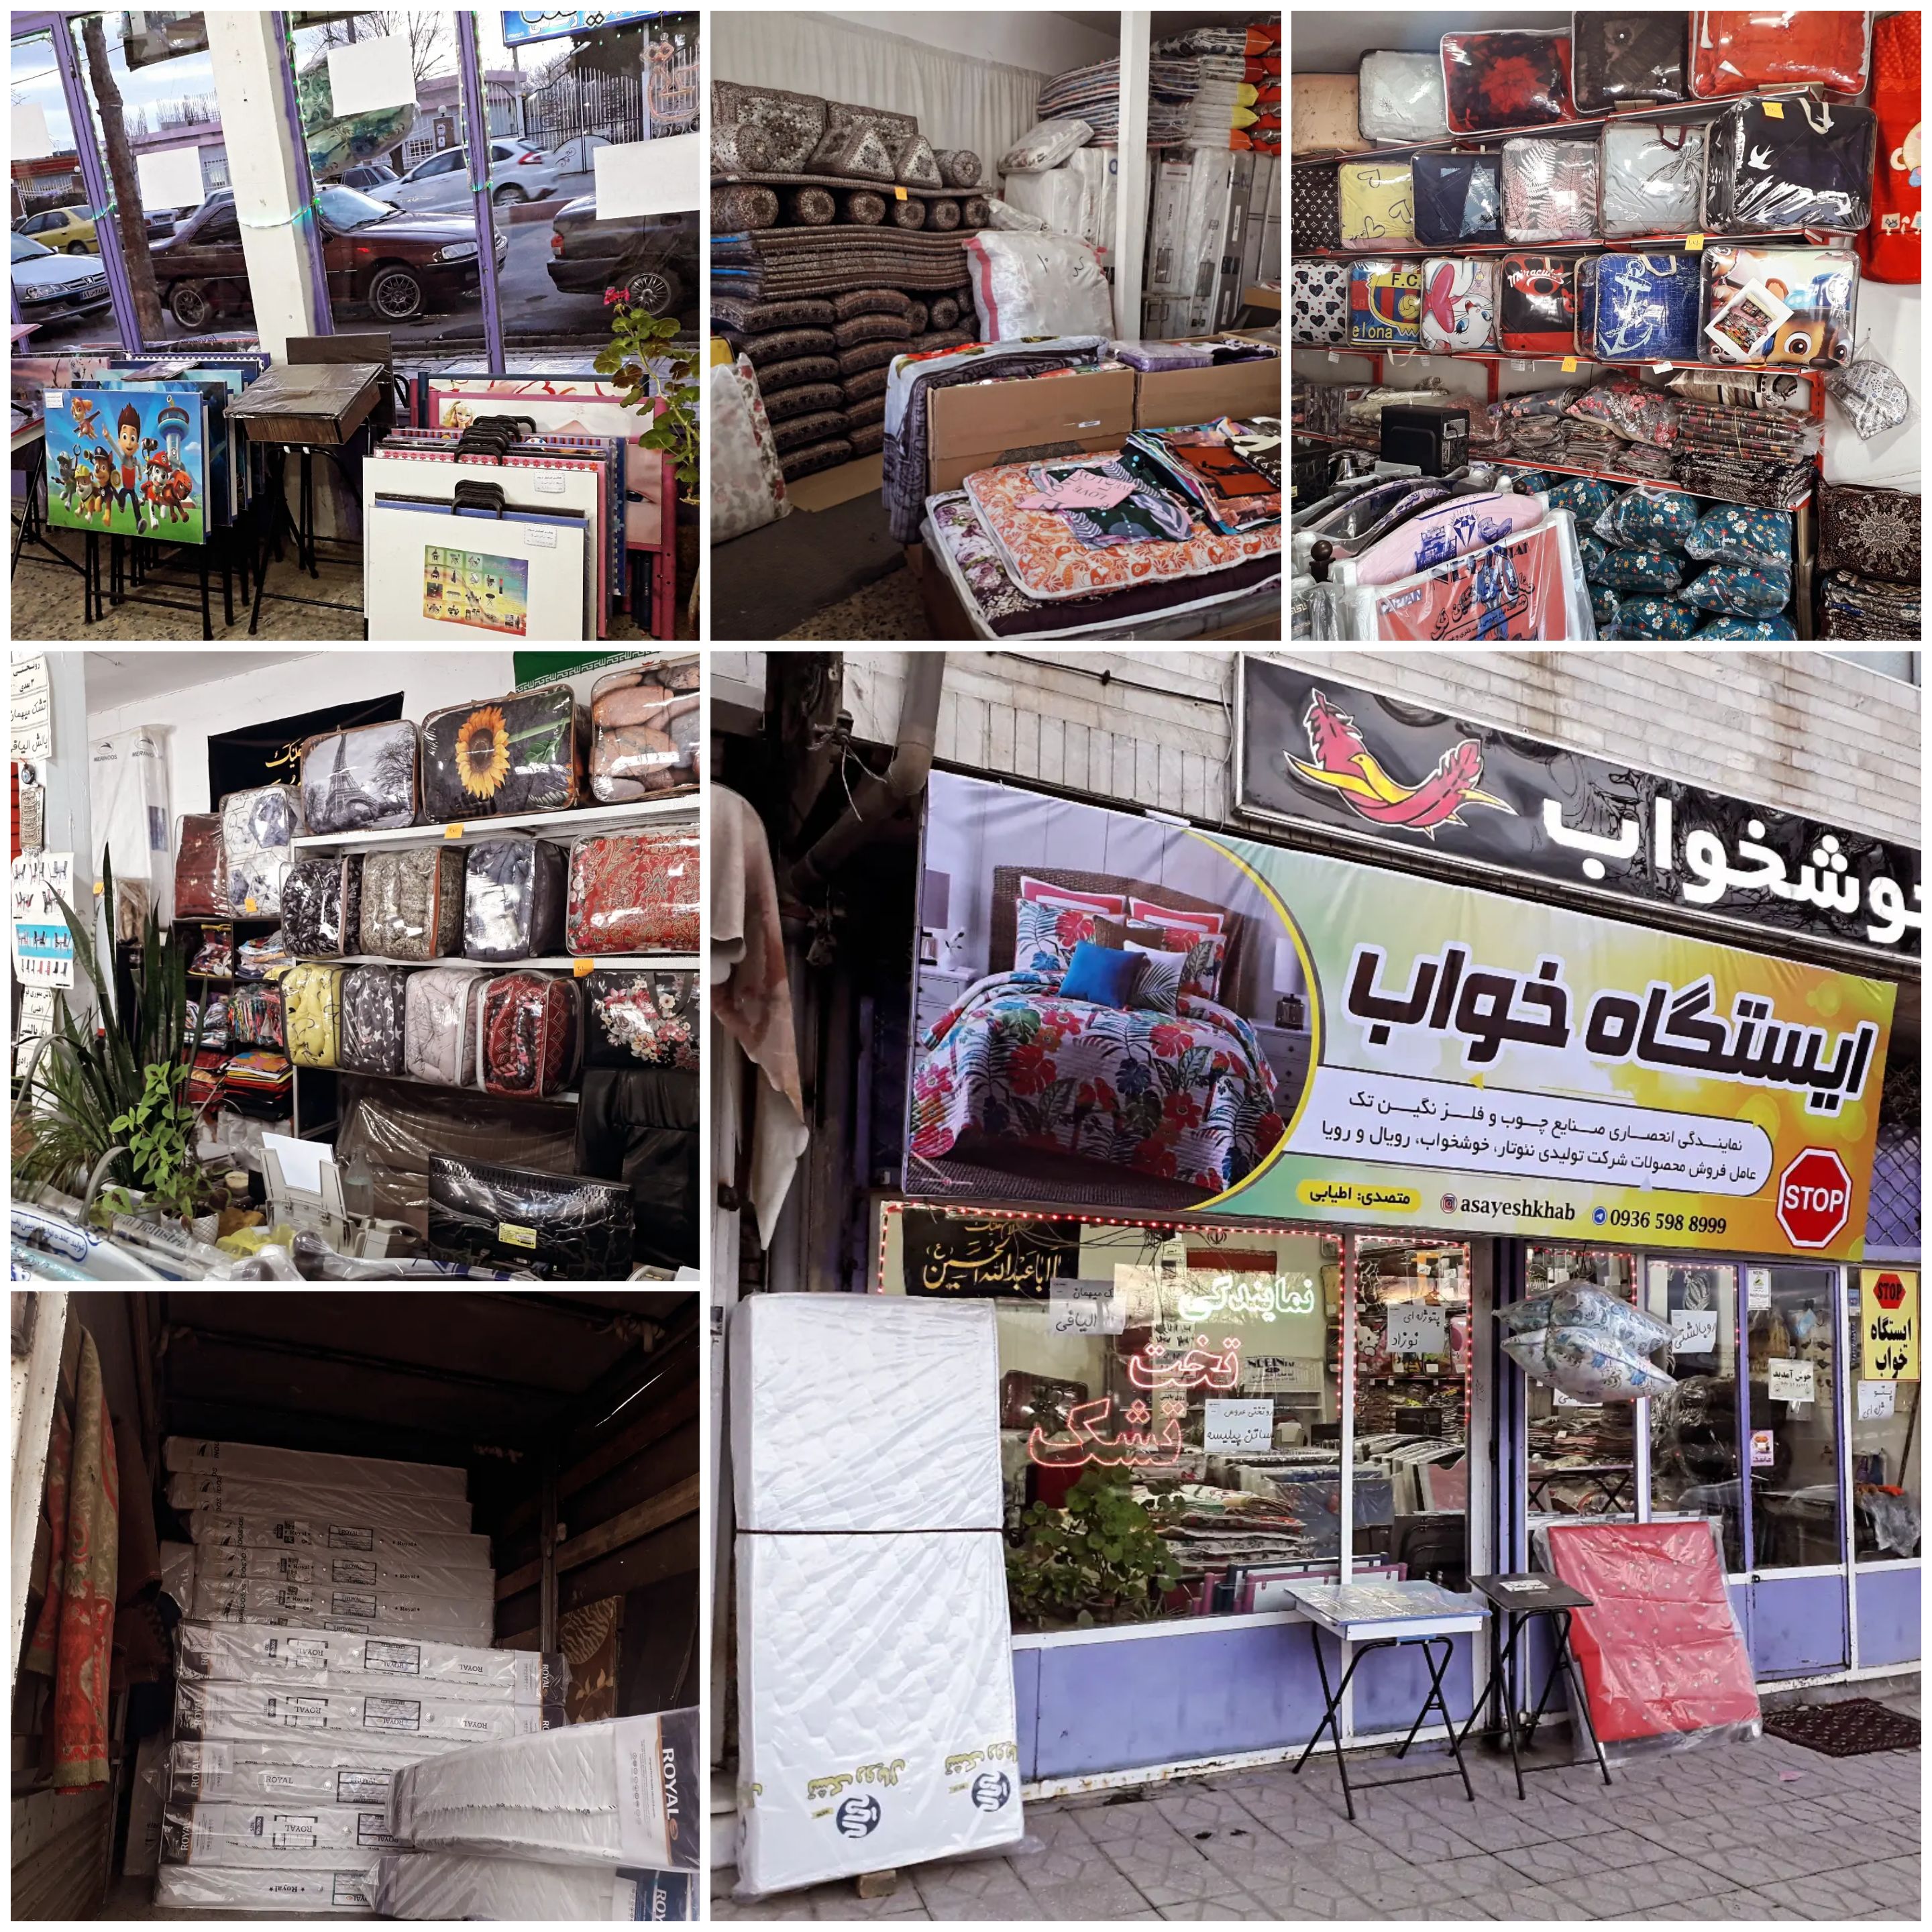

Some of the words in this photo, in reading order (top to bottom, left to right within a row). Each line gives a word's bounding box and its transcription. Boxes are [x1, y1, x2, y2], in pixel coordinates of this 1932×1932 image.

[11, 740, 31, 753] الیاف
[1543, 796, 1921, 945] وشخواب
[1347, 948, 1570, 1063] خواب
[1587, 981, 1877, 1111] ایستگاه
[1348, 1091, 1374, 1108] تک
[1377, 1098, 1437, 1119] نگین
[1440, 1102, 1485, 1121] فلز
[1489, 1114, 1497, 1126] و
[1322, 1120, 1351, 1142] رویا
[1356, 1128, 1364, 1143] و
[1501, 1114, 1548, 1135] چوب
[1551, 1118, 1606, 1140] صنایع
[1368, 1126, 1411, 1148] رویال
[1415, 1133, 1490, 1155] خوشخواب،
[1609, 1128, 1675, 1144] انحصاری
[1678, 1130, 1742, 1152] نمایندگی
[1538, 1144, 1585, 1166] تولیدی
[1587, 1150, 1628, 1169] شرکت
[1631, 1152, 1686, 1175] محصولات
[1688, 1163, 1726, 1180] فروش
[1729, 1162, 1757, 1181] عامل
[1309, 1184, 1352, 1203] اطیابی
[1356, 1191, 1411, 1205] متصدی:
[1784, 1183, 1845, 1214] STOP
[1460, 1197, 1576, 1222] asayeshkhab
[1610, 1209, 1650, 1228] 0936
[1655, 1212, 1684, 1232] 598
[1688, 1214, 1727, 1234] 8999
[1178, 1275, 1315, 1323] نمایندگی
[1877, 1283, 1902, 1301] STOP
[1391, 1332, 1419, 1350] نوزاد
[1870, 1316, 1912, 1349] ایستگاه
[1128, 1334, 1242, 1390] تخت
[1875, 1348, 1908, 1379] خواب
[1028, 1397, 1187, 1467] تشک
[542, 1664, 550, 1689] ROYAL
[294, 1705, 322, 1715] ROYAL
[987, 1741, 1018, 1764] رویا
[191, 1758, 201, 1788] ROYAL
[264, 1776, 294, 1784] ROYAL
[663, 1748, 680, 1821] ROYAL
[806, 1773, 853, 1800] تشک
[285, 1824, 313, 1833] ROYAL
[275, 1884, 298, 1893] Royal
